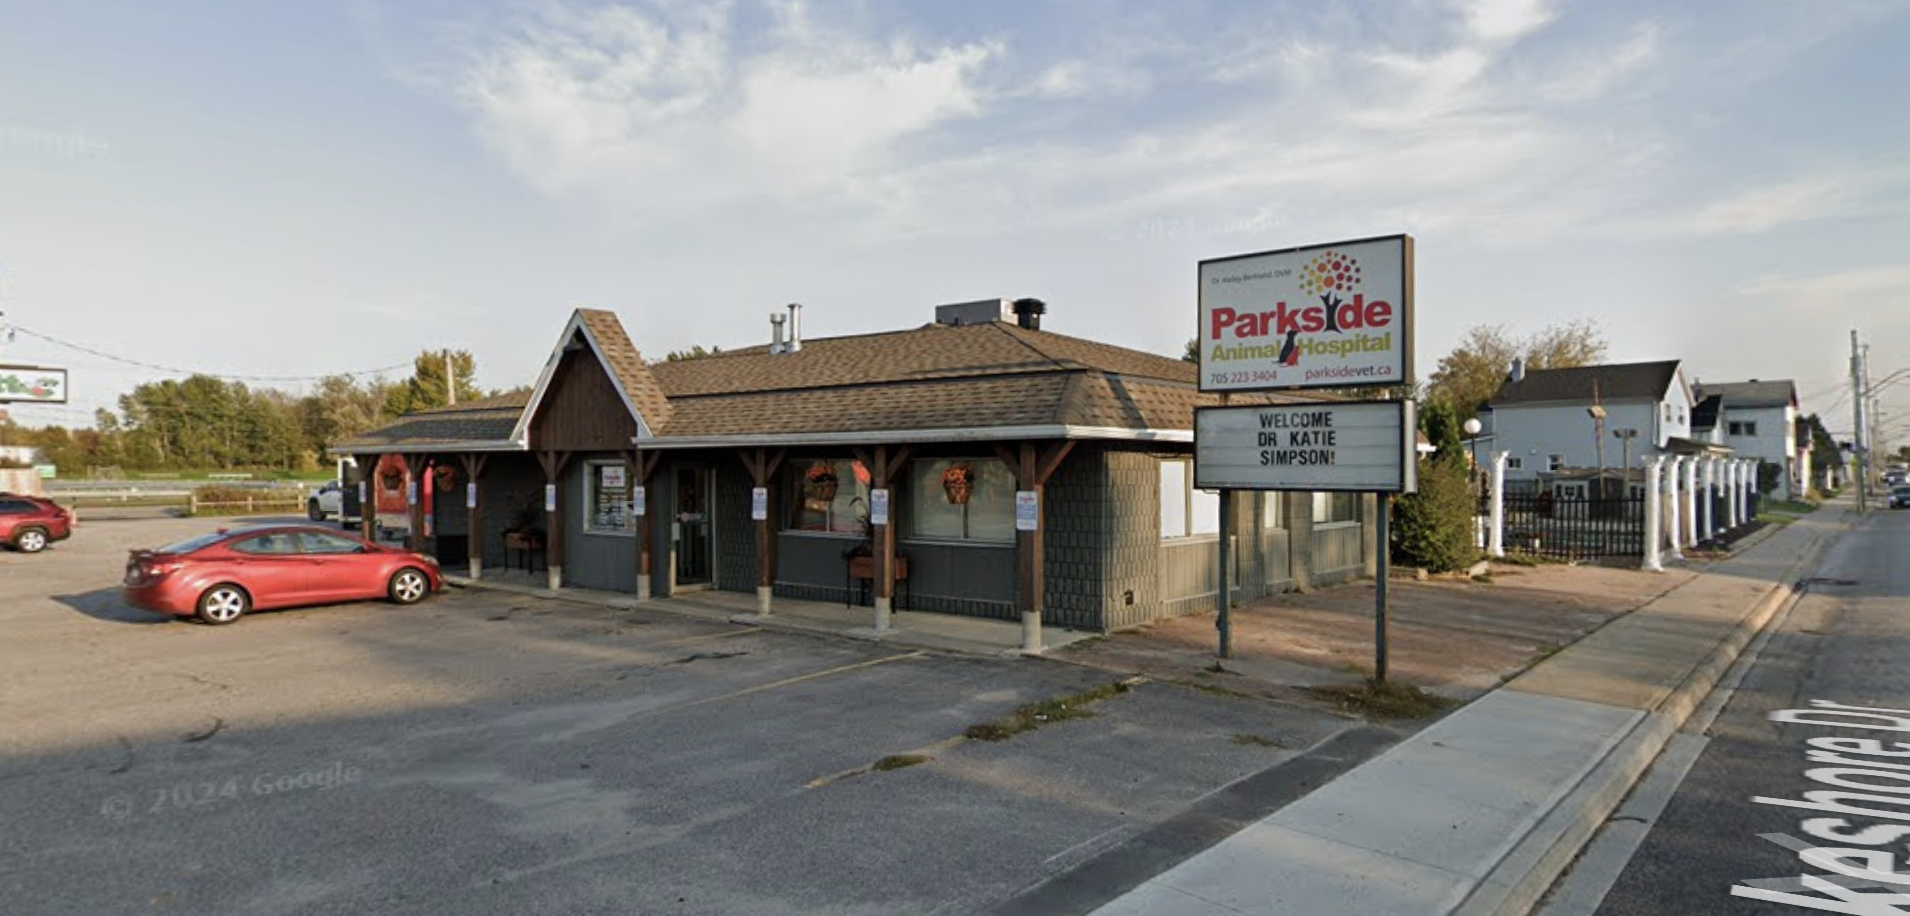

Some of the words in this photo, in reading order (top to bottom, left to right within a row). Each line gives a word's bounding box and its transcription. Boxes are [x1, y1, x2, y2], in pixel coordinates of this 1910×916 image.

[1211, 291, 1393, 340] Parkside
[1211, 339, 1282, 362] Animal
[1297, 331, 1392, 357] Hospital
[1210, 373, 1229, 384] 705
[1230, 372, 1250, 383] 223
[1251, 370, 1278, 382] 3404
[1305, 364, 1392, 381] parksidevet.ca
[1259, 411, 1334, 428] WELCOME
[1258, 431, 1277, 447] DR
[1290, 430, 1336, 447] KATIE
[1261, 449, 1336, 466] SIMPSON!
